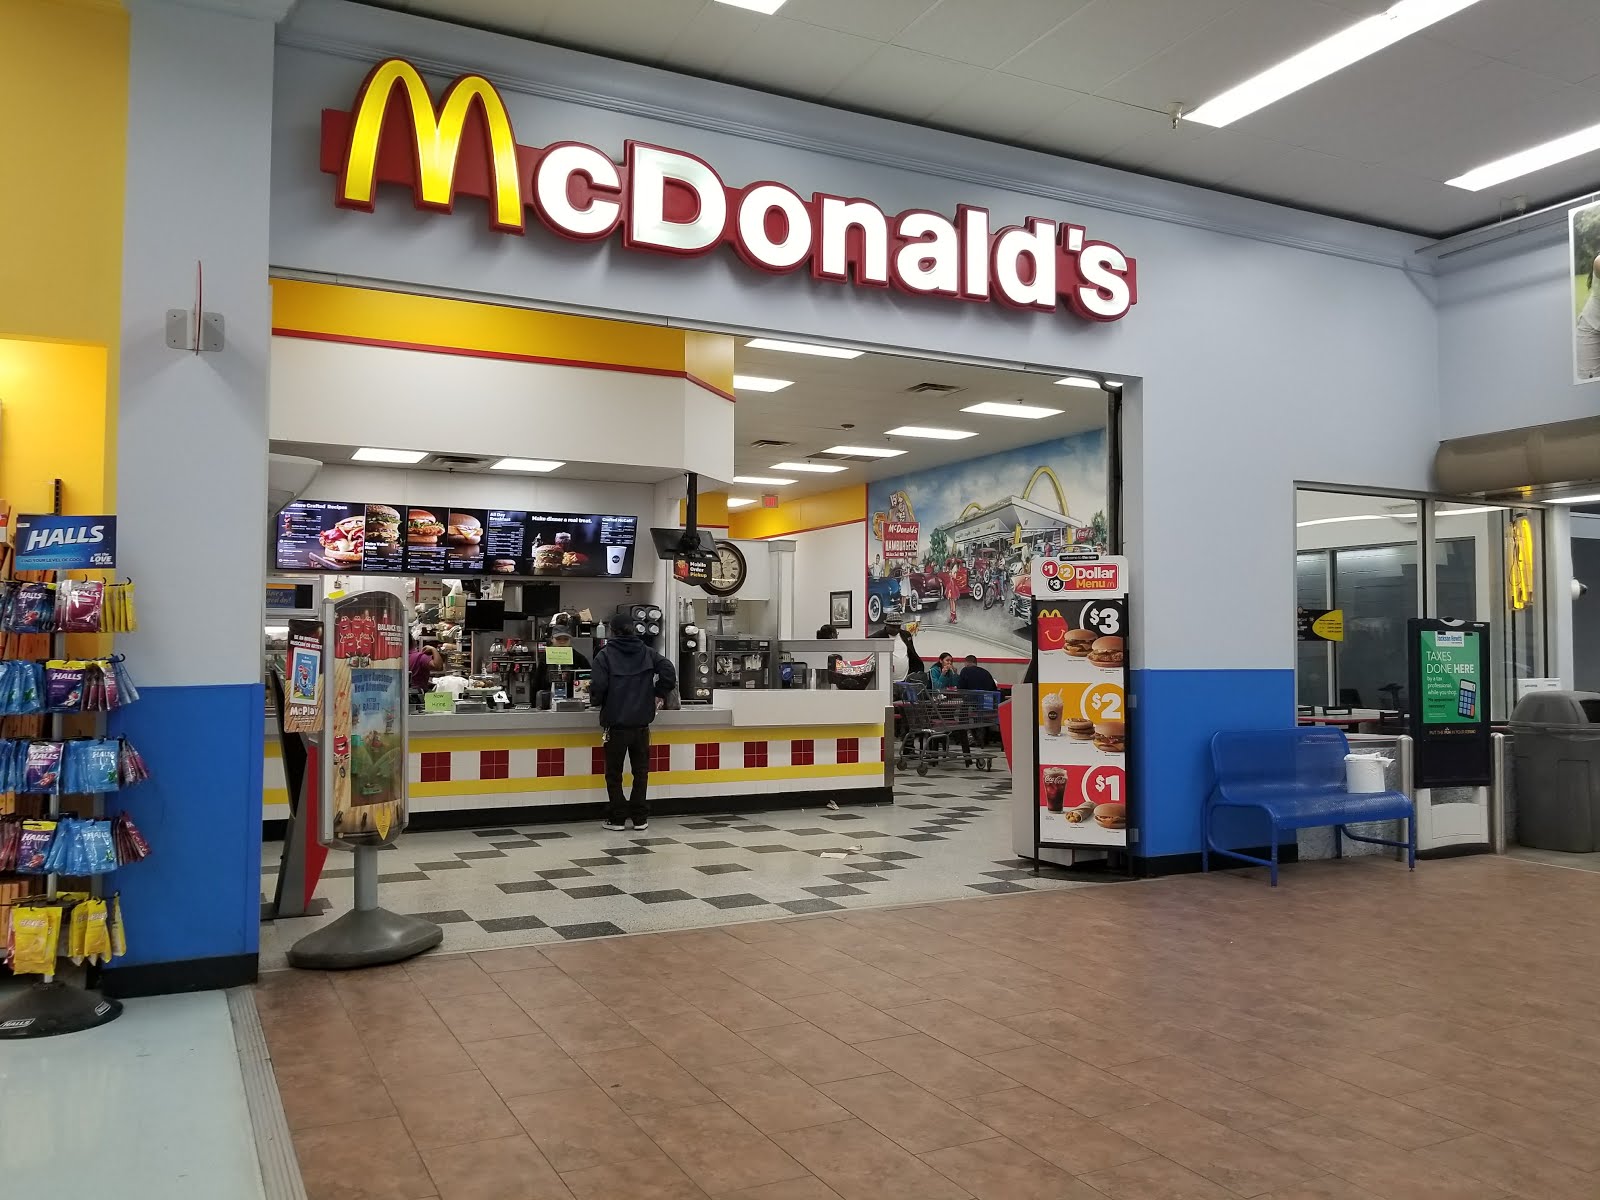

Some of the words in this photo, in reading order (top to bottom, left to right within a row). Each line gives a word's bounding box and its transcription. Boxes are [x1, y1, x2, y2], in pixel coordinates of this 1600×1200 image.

[336, 59, 1131, 318] McDonald's
[26, 525, 105, 551] HALLS
[1044, 564, 1054, 574] $1
[1060, 567, 1071, 578] $2
[1075, 567, 1115, 579] Dollar
[1050, 579, 1060, 589] $3
[1076, 579, 1106, 589] Menu
[1089, 607, 1120, 635] $3
[1426, 651, 1452, 662] TAXES
[1426, 663, 1453, 674] DONE
[1453, 663, 1475, 674] HERE
[52, 672, 83, 681] HALLS
[290, 706, 319, 716] McPlay
[1091, 692, 1122, 719] $2
[29, 752, 59, 760] HALLS
[1094, 774, 1120, 801] $1
[21, 832, 50, 842] HALLS
